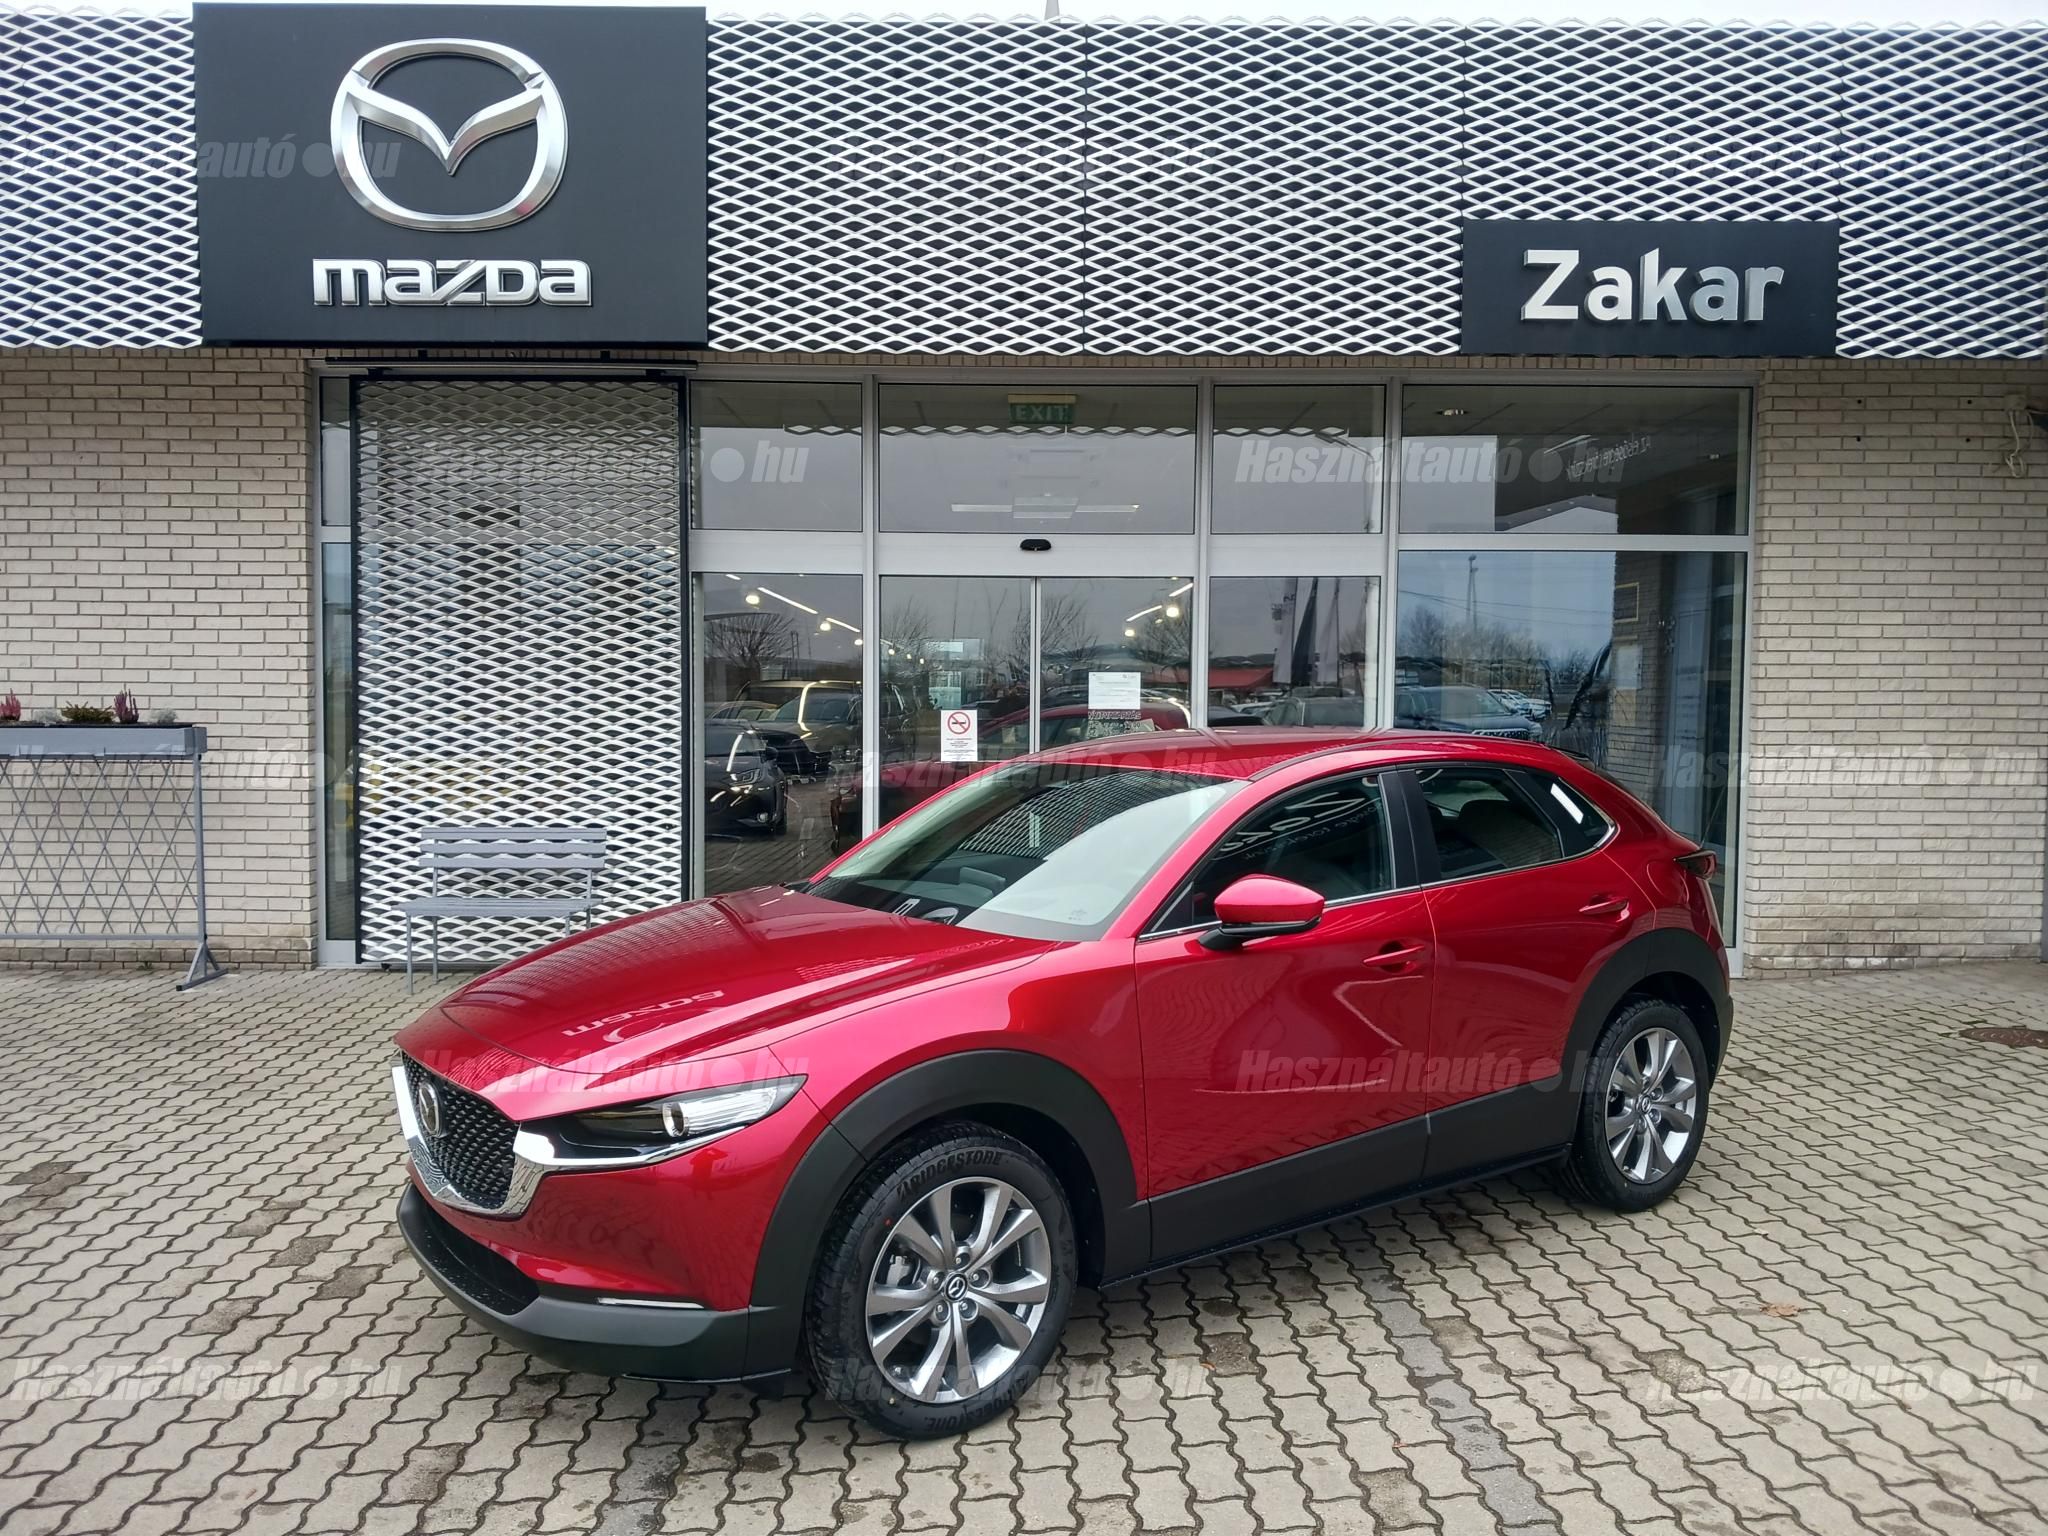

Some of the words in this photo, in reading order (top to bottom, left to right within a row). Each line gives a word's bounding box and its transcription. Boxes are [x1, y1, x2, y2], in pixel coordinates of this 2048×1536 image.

[312, 258, 592, 306] mazda
[1521, 248, 1784, 323] Zakar
[1015, 404, 1069, 421] EXIT
